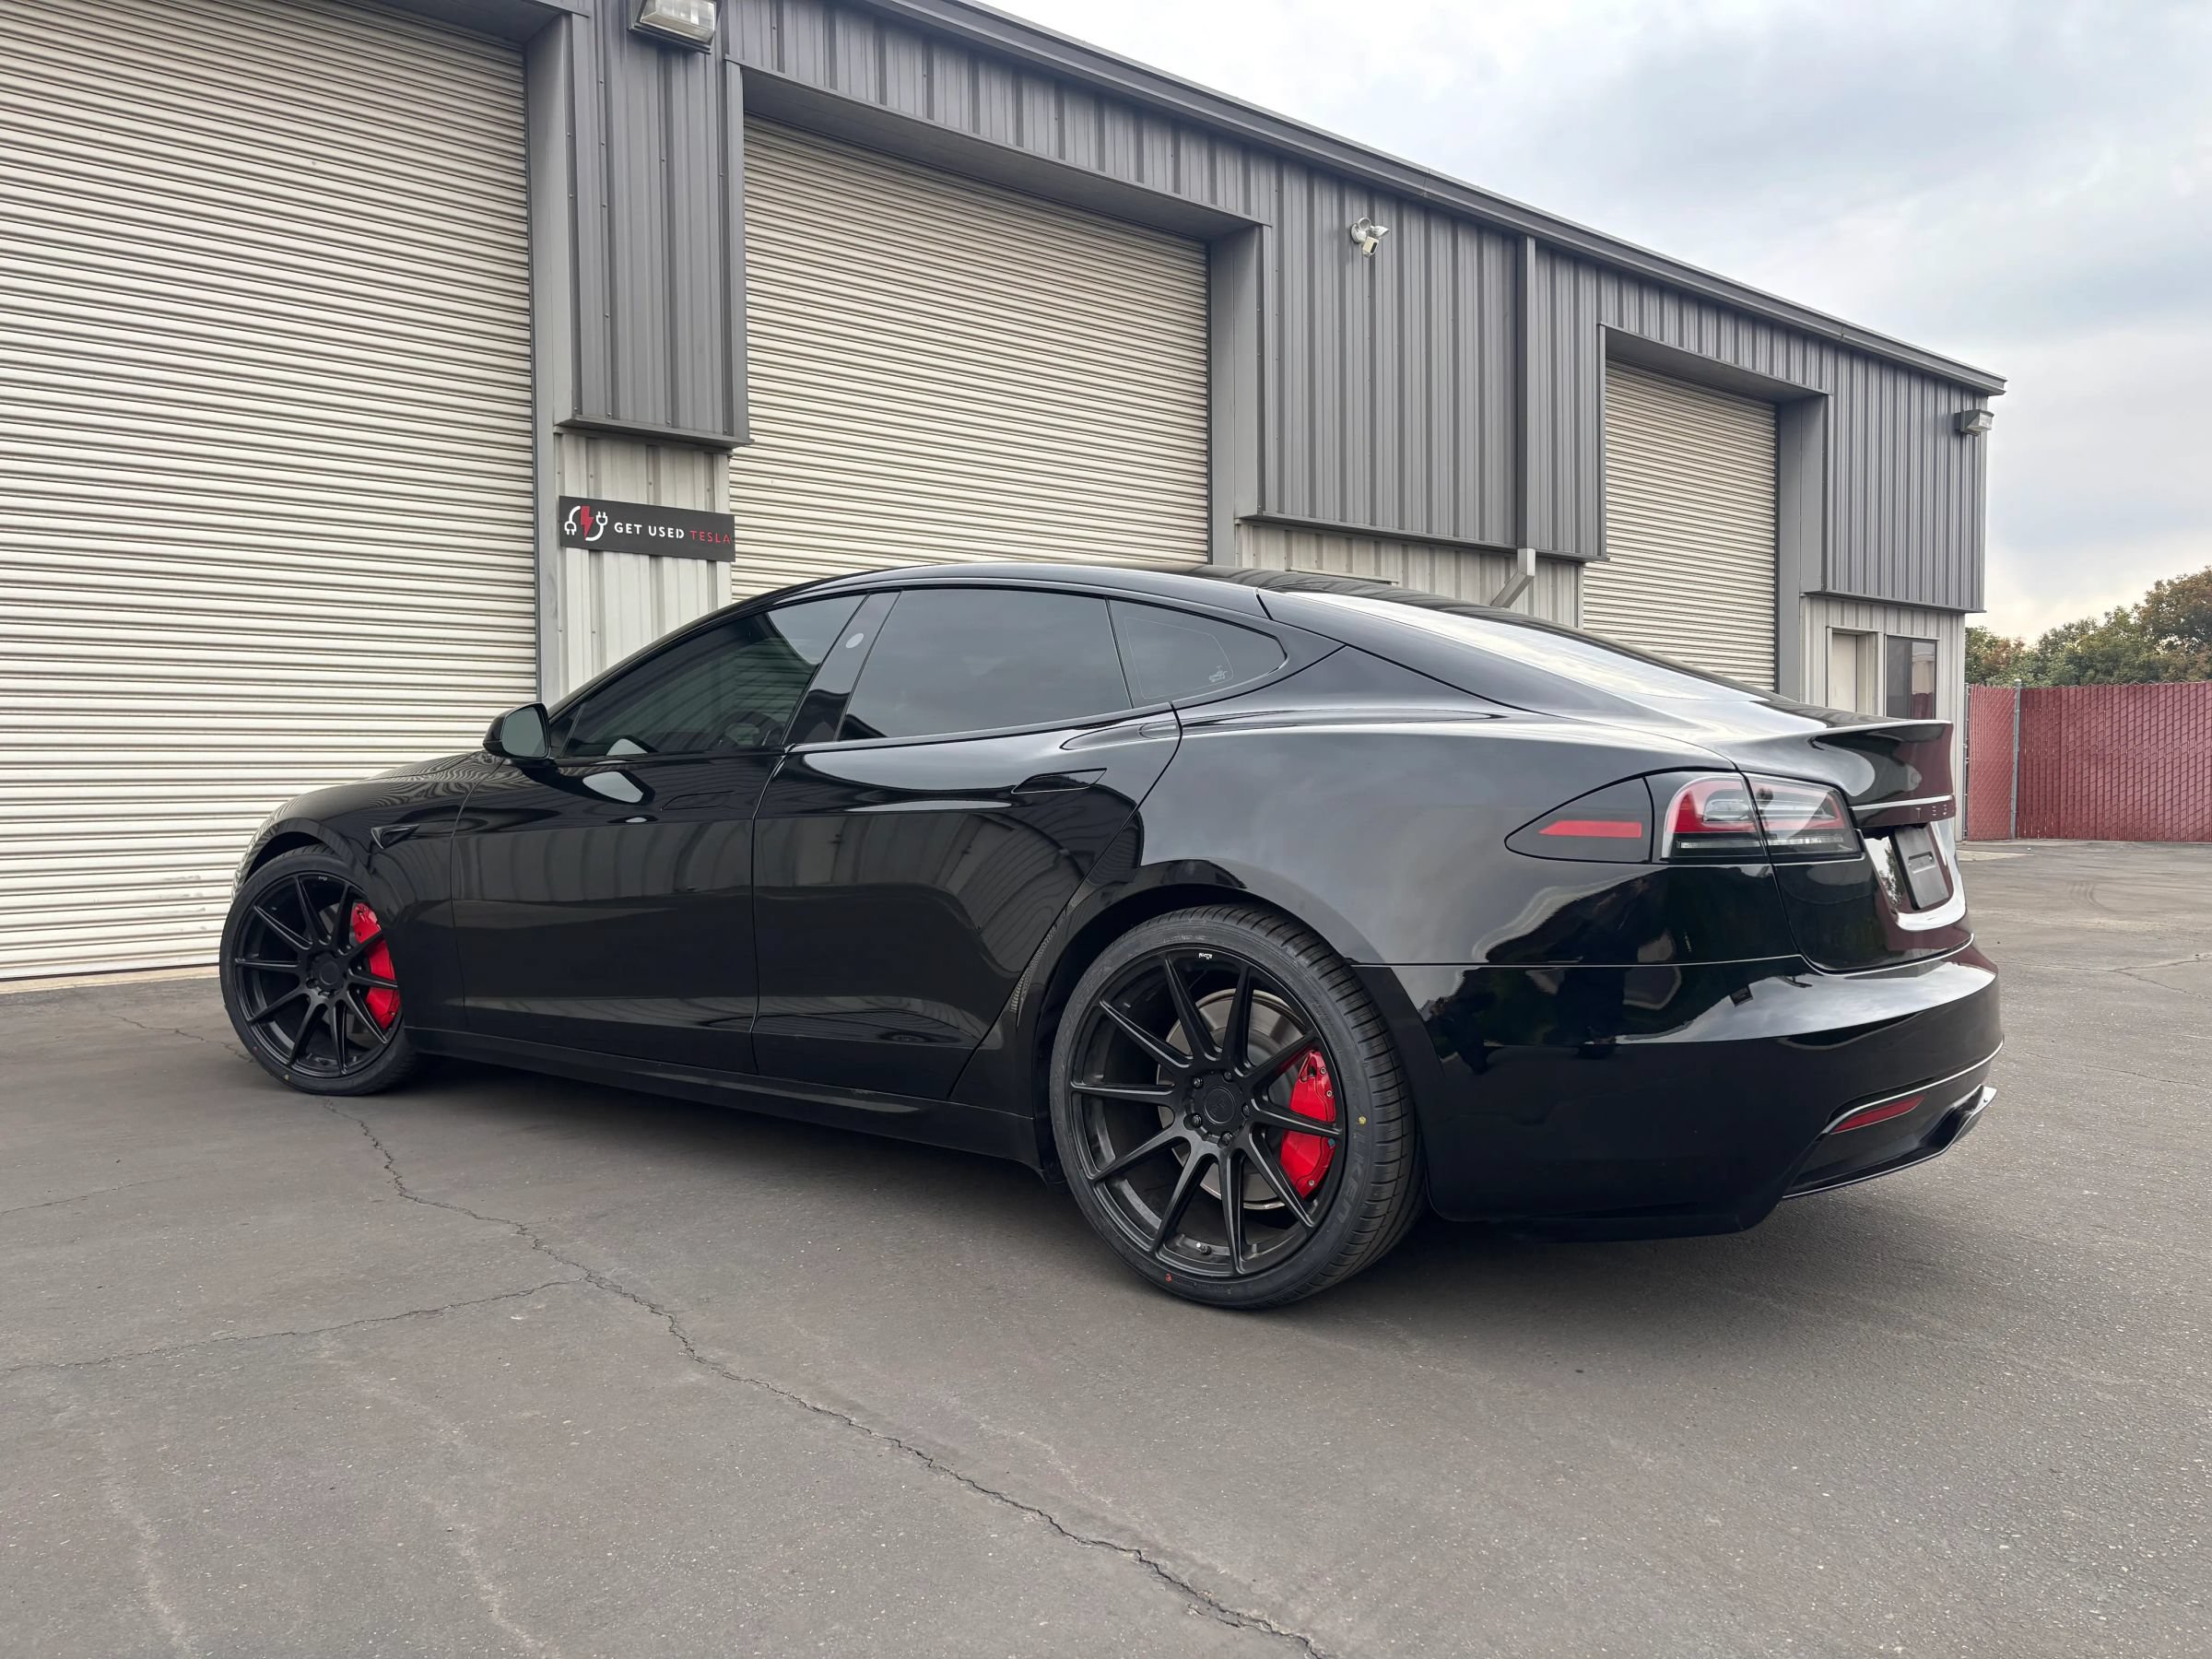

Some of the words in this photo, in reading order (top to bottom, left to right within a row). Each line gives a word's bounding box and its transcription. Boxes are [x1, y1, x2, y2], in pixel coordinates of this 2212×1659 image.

[614, 522, 642, 535] GET
[648, 525, 685, 539] USED
[690, 530, 731, 544] TESLA
